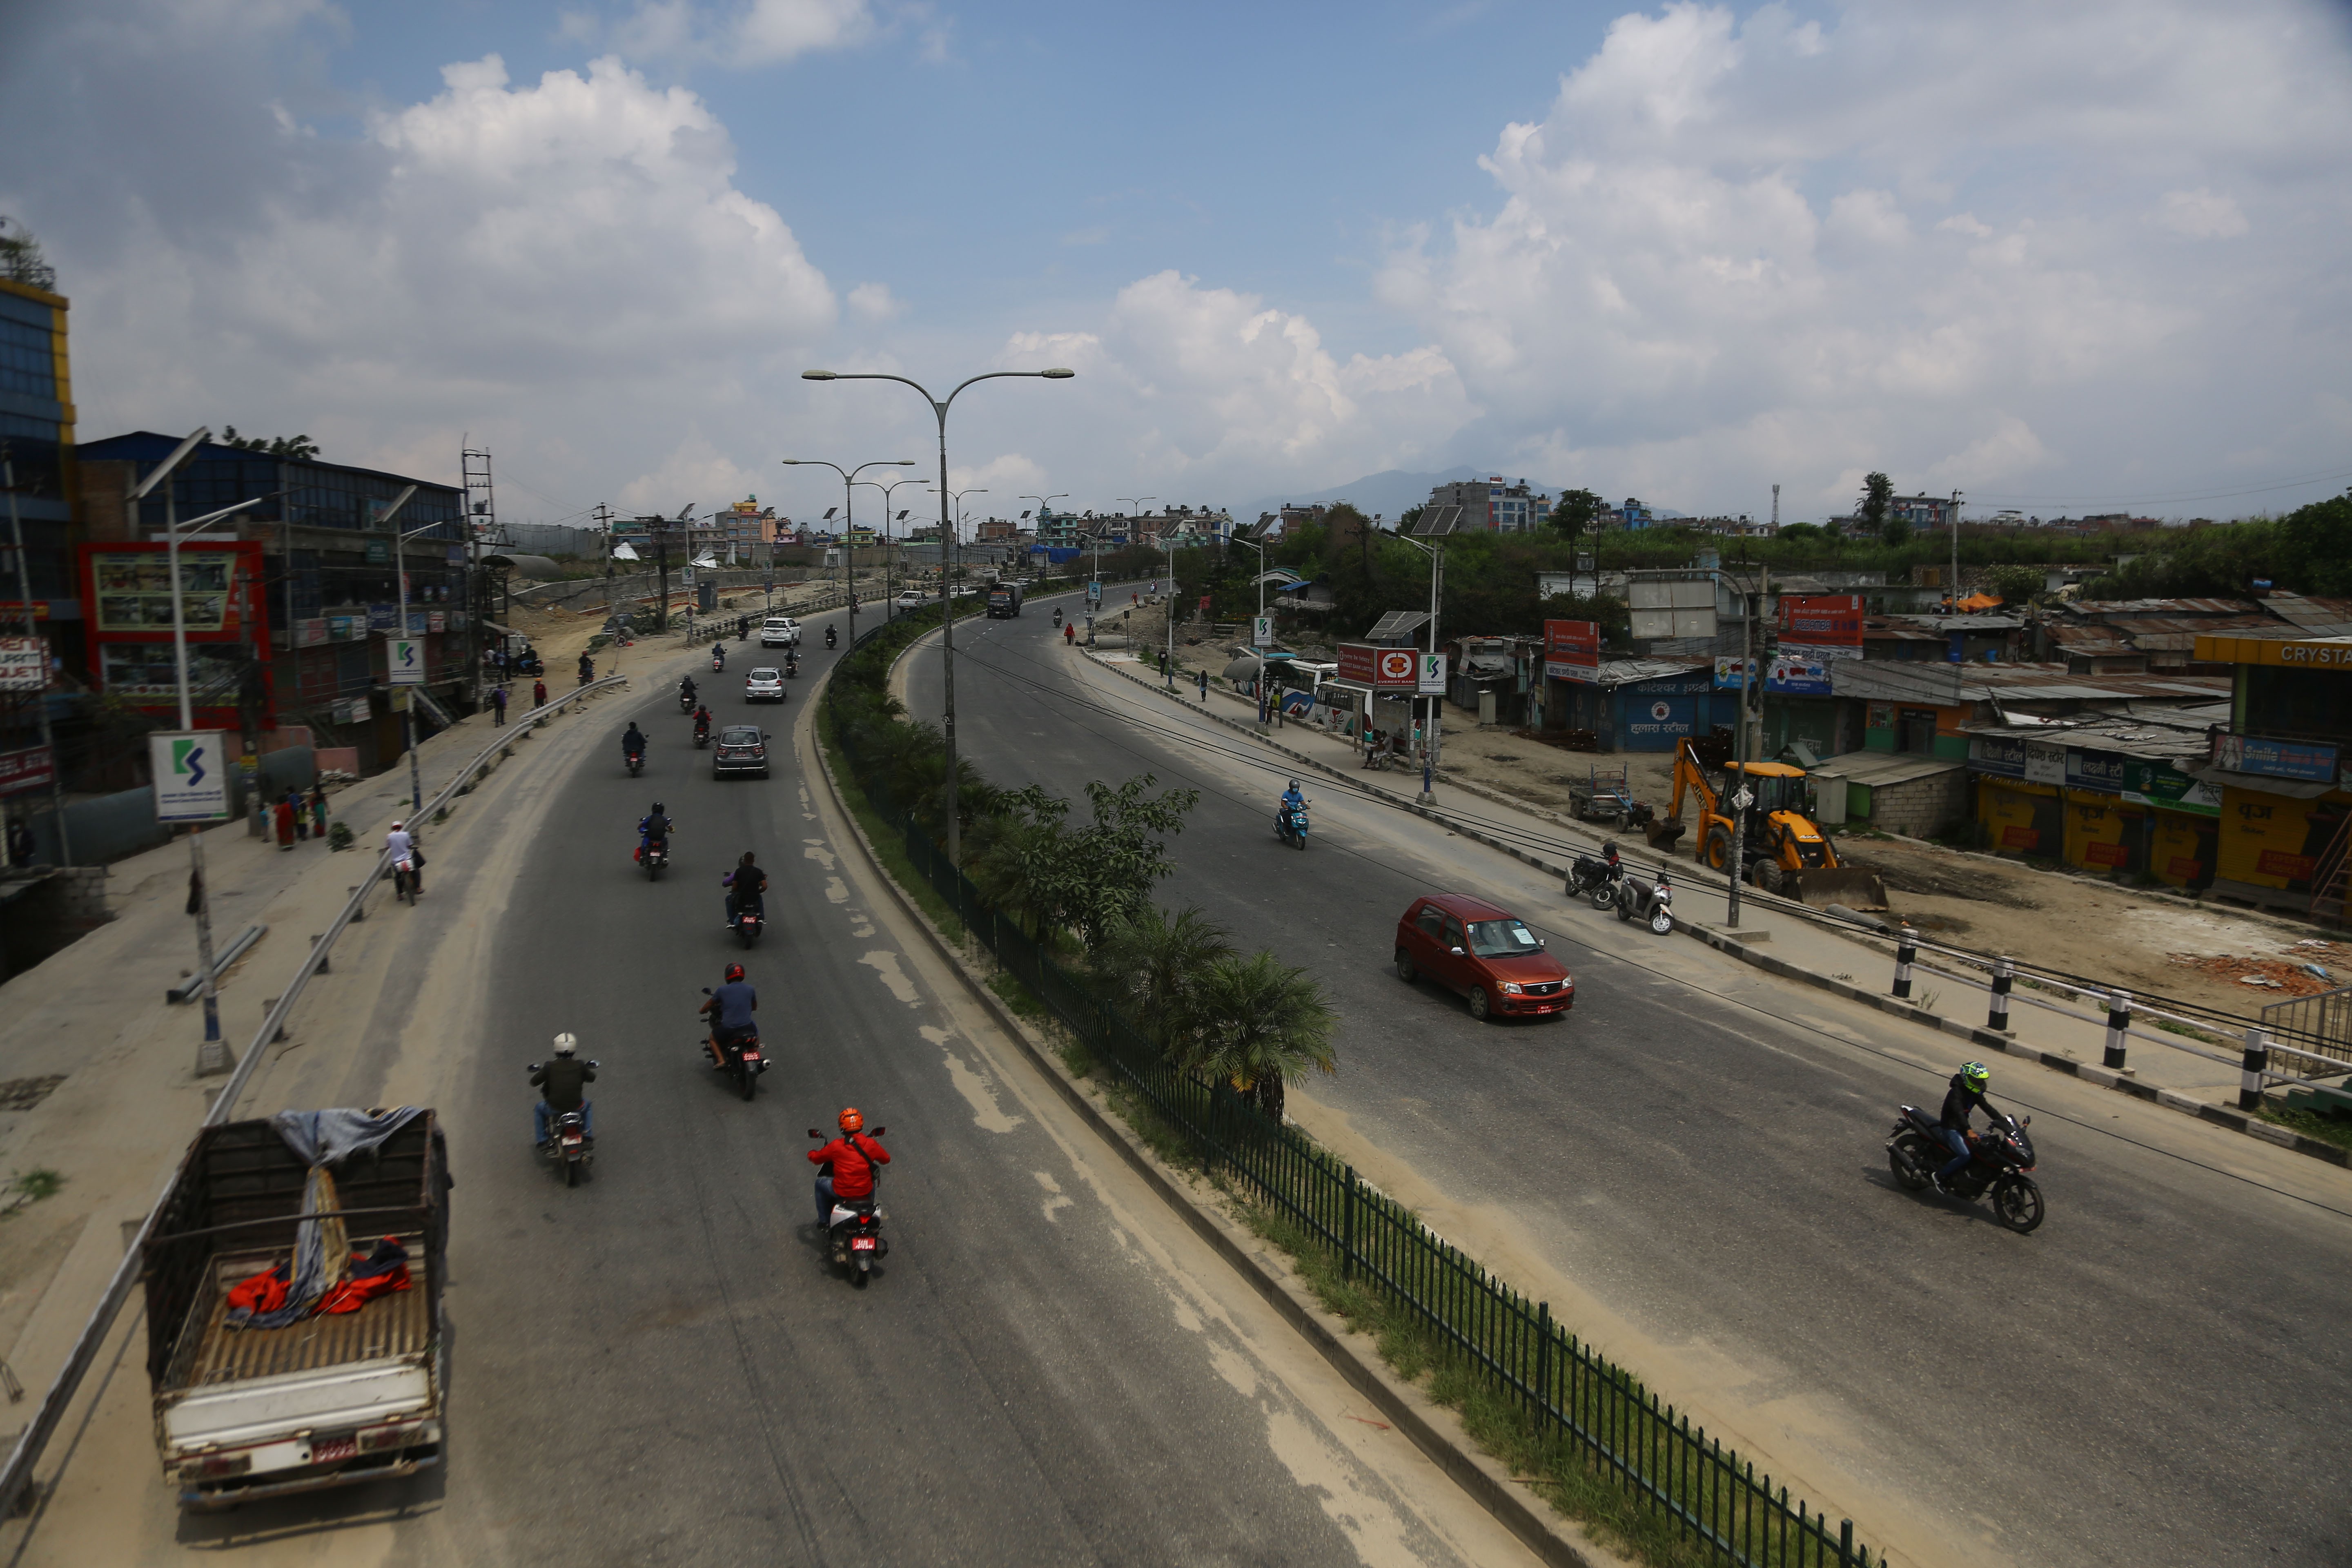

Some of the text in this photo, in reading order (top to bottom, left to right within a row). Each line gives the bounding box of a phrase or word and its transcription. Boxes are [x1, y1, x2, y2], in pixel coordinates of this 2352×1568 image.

[2281, 646, 2352, 664] CRYSTA
[1637, 681, 1677, 692] कोटेश्वर
[1631, 722, 1689, 734] हुलास स्टील
[2245, 745, 2278, 762] Smile
[2109, 763, 2123, 777] स्टी
